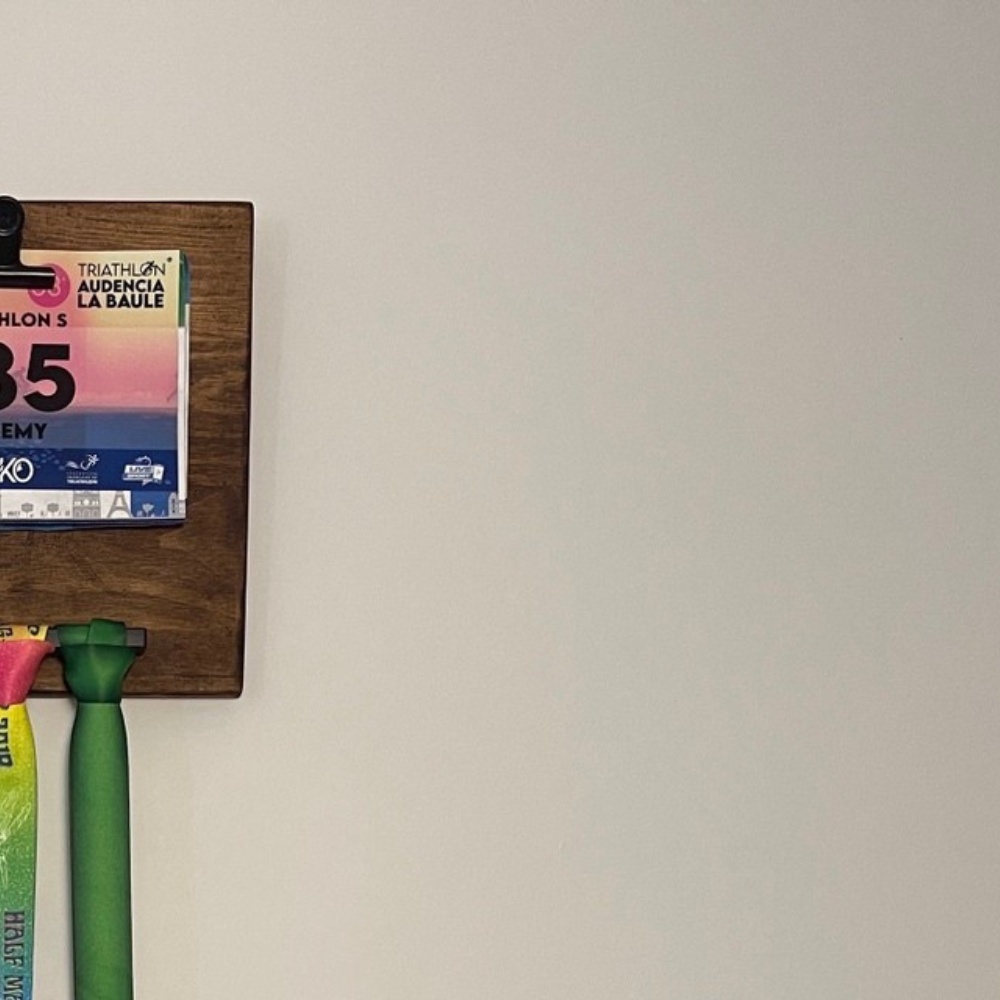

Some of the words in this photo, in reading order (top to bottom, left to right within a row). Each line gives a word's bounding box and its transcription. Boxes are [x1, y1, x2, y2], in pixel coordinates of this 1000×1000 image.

[77, 261, 166, 277] TRIATHLON
[77, 279, 165, 293] AUDENCIA
[77, 294, 102, 308] LA
[106, 294, 164, 308] BAULE
[57, 313, 68, 327] S
[3, 910, 26, 968] HALF
